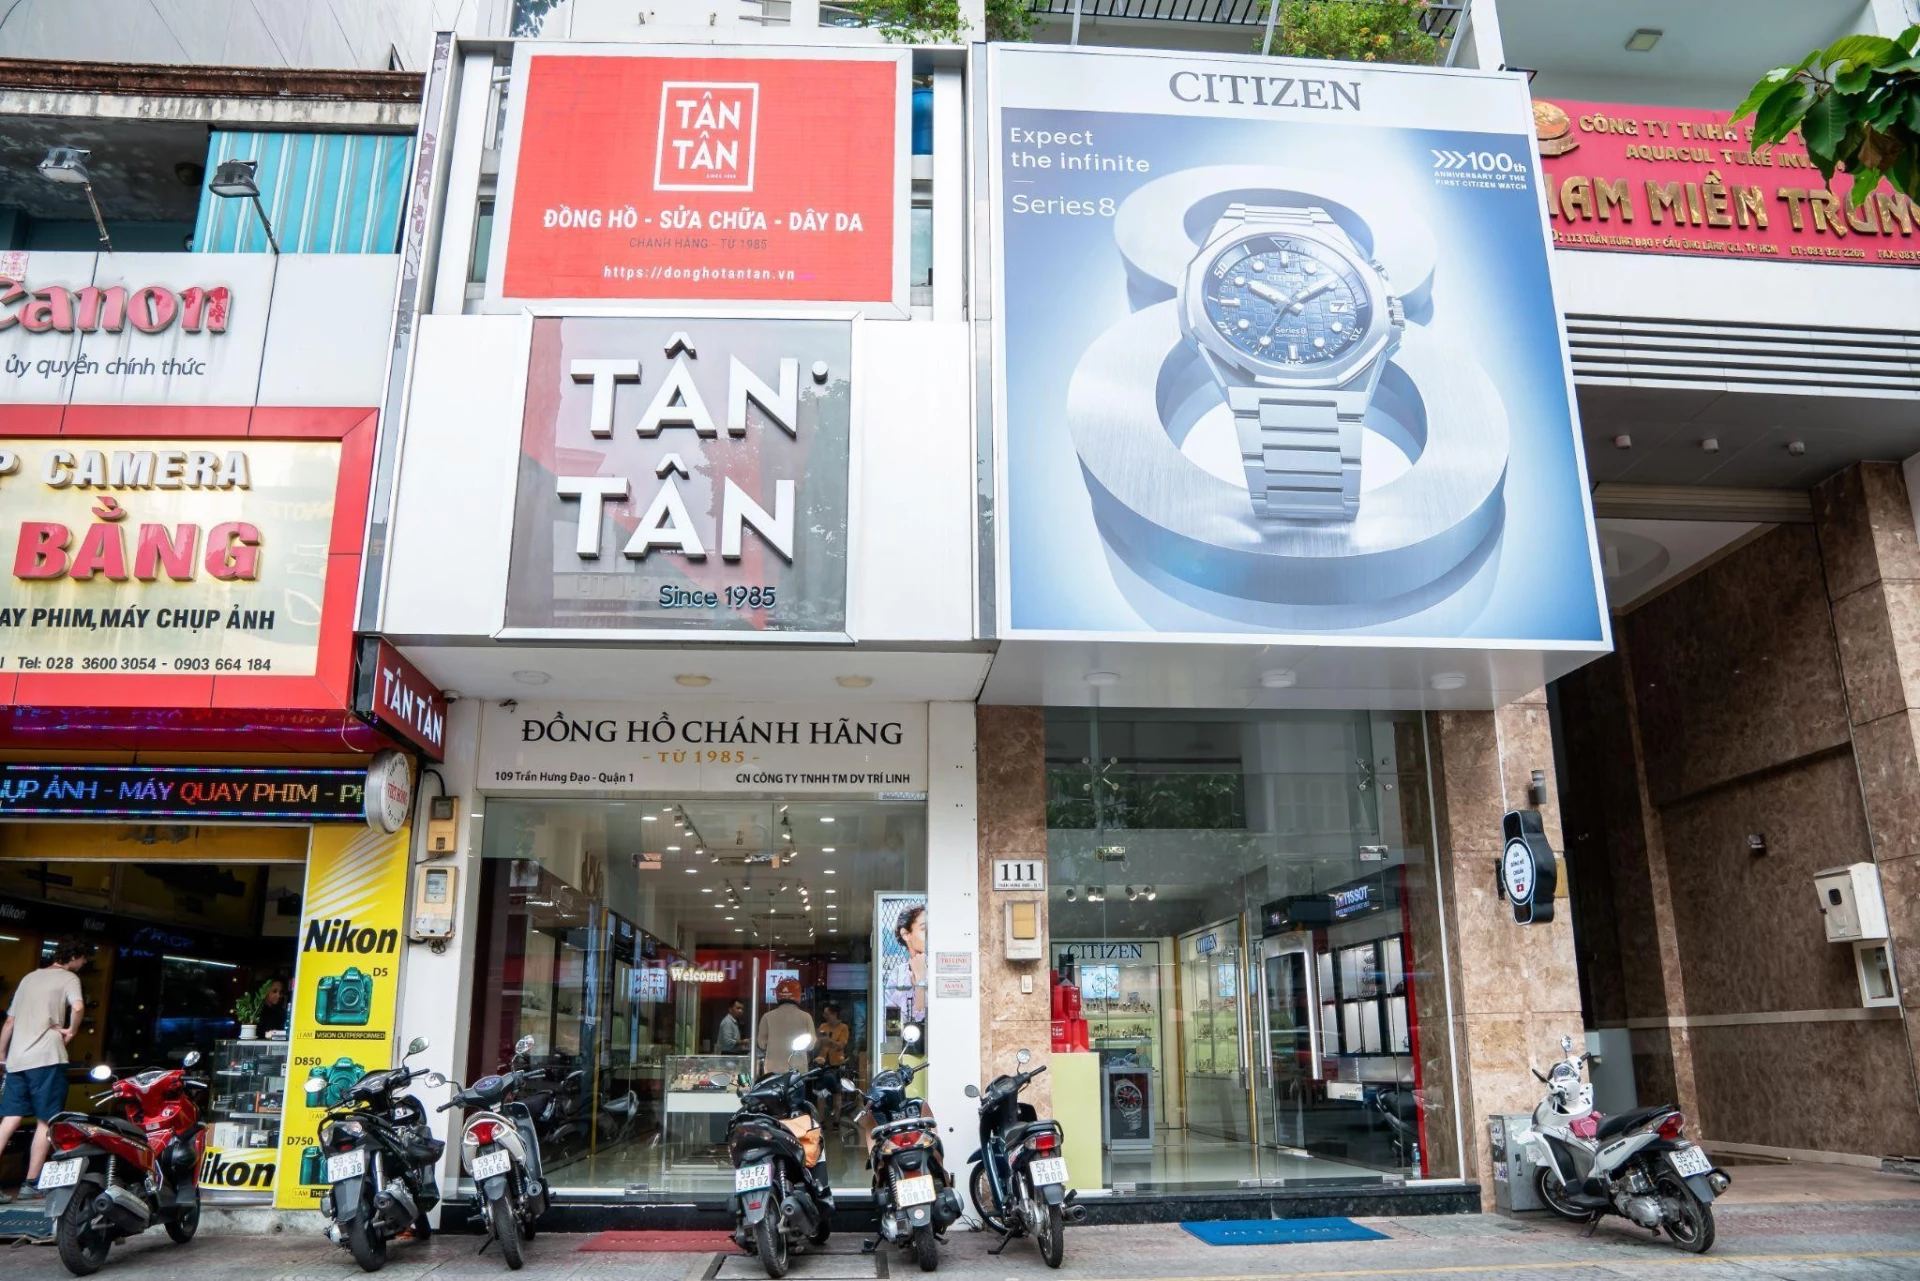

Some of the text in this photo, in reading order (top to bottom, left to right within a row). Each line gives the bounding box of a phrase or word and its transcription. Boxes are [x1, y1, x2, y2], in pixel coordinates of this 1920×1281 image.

[1169, 70, 1362, 112] CITIZEN
[676, 91, 741, 131] TÂN
[1579, 112, 1639, 137] CÔNG
[1643, 120, 1671, 138] TY
[1009, 126, 1094, 150] Expect
[672, 130, 738, 171] TÂN
[1011, 151, 1151, 174] the infinite
[1434, 171, 1493, 180] ANNIVERSARY
[1509, 174, 1526, 182] THE
[1435, 179, 1528, 190] FIRST CITIZEN WATCH
[1644, 169, 1769, 229] MIỀN
[543, 203, 602, 229] ĐỒNG
[607, 203, 638, 229] HỒ
[660, 204, 702, 230] SỬA
[708, 205, 767, 231] CHỮA
[788, 208, 829, 232] DÂY
[835, 213, 864, 232] DA
[741, 239, 767, 249] 1985
[603, 264, 796, 282] https://donghotantan.vn
[0, 276, 233, 335] Canon
[5, 353, 206, 379] ủy quyền chính thức
[570, 331, 800, 440] TÂN
[41, 449, 251, 490] CAMERA
[556, 453, 796, 566] TÂN
[13, 495, 262, 582] BẰNG
[658, 585, 777, 608] Since 1985
[156, 609, 221, 634] CHỤP
[226, 603, 276, 631] ẢNH
[18, 656, 42, 670] Tel:
[46, 657, 74, 670] 028
[82, 657, 118, 671] 3600
[121, 657, 157, 671] 3054
[174, 658, 210, 672] 0903
[215, 658, 242, 672] 664
[247, 658, 272, 672] 184
[383, 667, 414, 726] TÂN
[416, 694, 444, 749] TÂN
[521, 711, 904, 745] ĐỒNG HỒ CHÁNH HÃNG
[658, 748, 687, 764] TỪ
[695, 751, 745, 764] 1985
[44, 775, 98, 800] ẢNH
[119, 777, 175, 801] MÁY
[179, 781, 249, 805] QUAY
[253, 783, 318, 803] PHIM
[495, 771, 514, 781] 109
[540, 772, 567, 784] Hưng
[570, 772, 591, 784] Đạo
[599, 772, 626, 785] Quận
[629, 773, 635, 783] 1
[736, 772, 910, 784] CN CÔNG TY TNHH TM DV TRÍ LINH
[1001, 862, 1037, 882] 111
[303, 918, 398, 954] Nikon
[1067, 944, 1143, 960] CITIZEN
[373, 967, 389, 977] D5
[670, 966, 725, 983] Welcome
[337, 1032, 385, 1040] OUTPERFORMED
[294, 1056, 322, 1066] D850
[287, 1136, 314, 1146] D750
